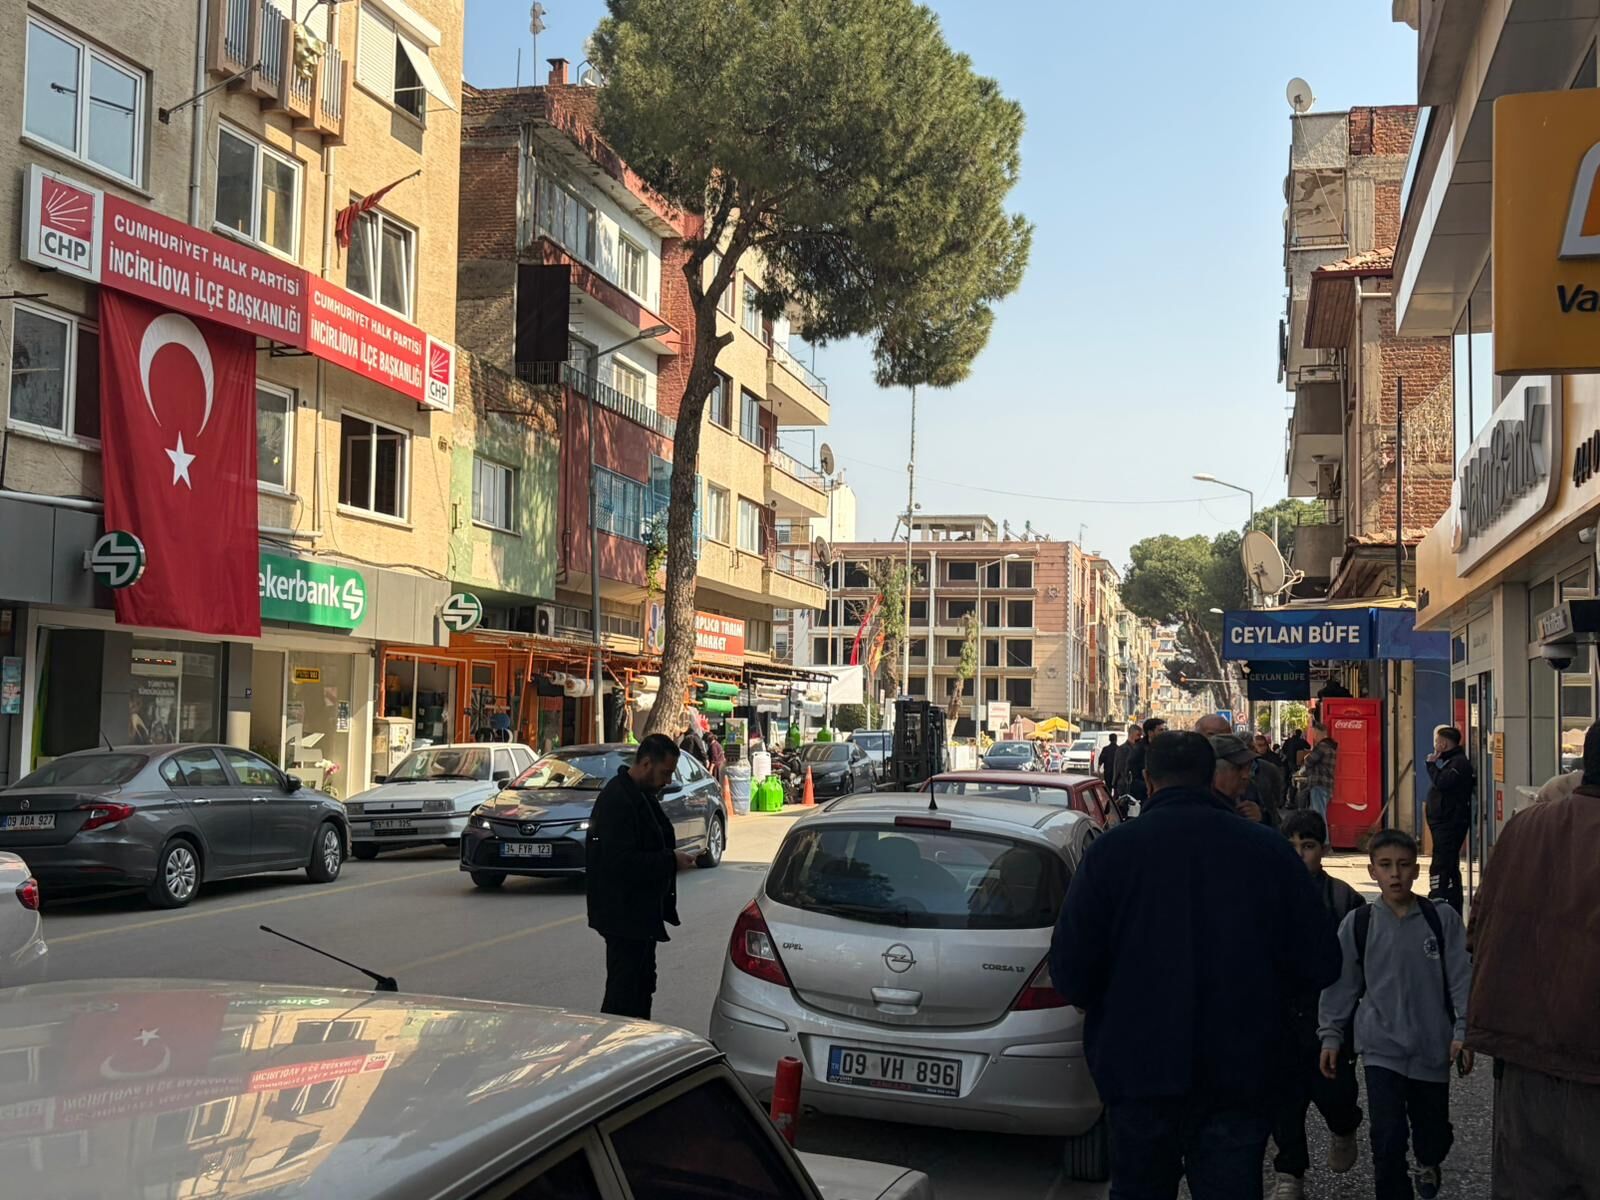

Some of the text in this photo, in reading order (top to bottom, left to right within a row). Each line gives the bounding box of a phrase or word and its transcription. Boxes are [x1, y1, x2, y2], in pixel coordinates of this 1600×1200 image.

[44, 231, 87, 262] CHP
[114, 214, 299, 297] CUMHURİYET HALK PARTİSİ
[109, 241, 301, 334] İNCİRLİOVA İLÇE BAŞKANLIĞI
[1556, 283, 1600, 313] Va
[314, 290, 422, 356] CUMHURİYET HALK PARTİSİ
[311, 313, 423, 389] İNCİRLİOVA İLÇE BAŞKANLIĞI
[429, 380, 447, 401] CHP
[259, 563, 340, 608] ekerbank
[695, 615, 720, 634] APLICA
[1231, 621, 1360, 644] CEYLAN BÜFE
[696, 631, 727, 651] MARKET
[1250, 671, 1305, 681] CEYLAN BÜFE
[7, 814, 54, 827] 09 ADA 927
[782, 942, 803, 951] OPEL
[982, 962, 1014, 973] CORSA
[842, 1052, 867, 1076] 09
[880, 1056, 905, 1081] VH
[916, 1060, 955, 1087] 896
